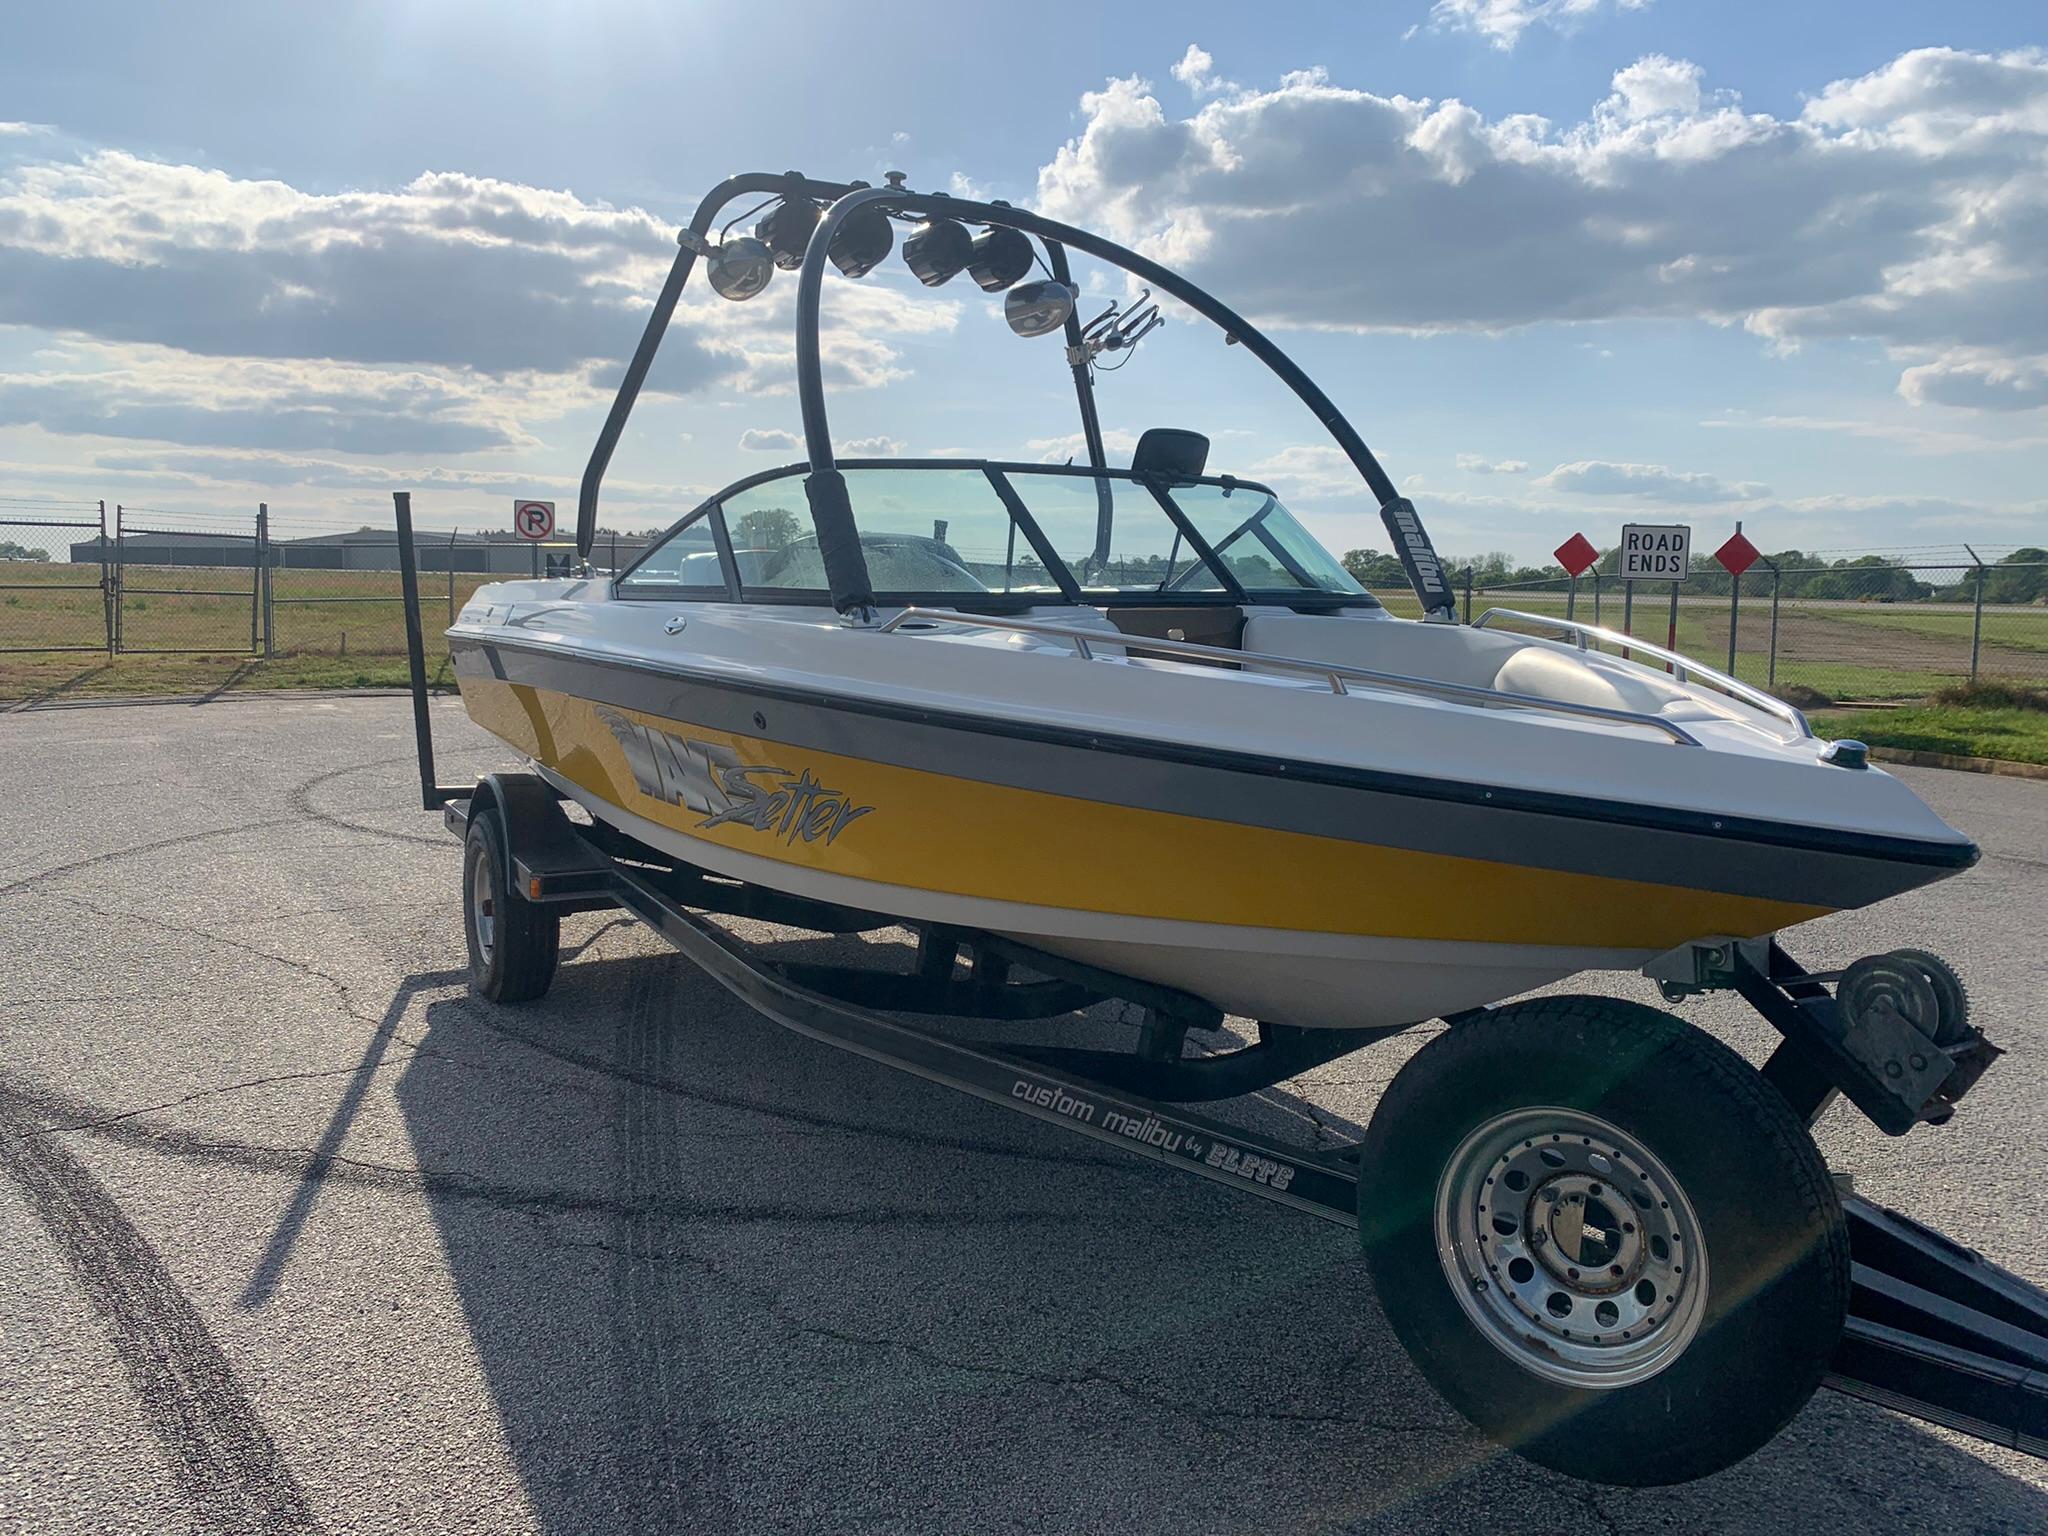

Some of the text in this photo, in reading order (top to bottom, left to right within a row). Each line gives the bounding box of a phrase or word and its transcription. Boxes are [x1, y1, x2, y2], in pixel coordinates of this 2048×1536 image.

[1394, 511, 1444, 593] malibu
[1628, 533, 1683, 551] ROAD
[1628, 554, 1681, 572] ENDS
[694, 768, 876, 846] Setter
[1011, 1080, 1095, 1122] custom
[1102, 1111, 1182, 1152] malibu
[1184, 1135, 1202, 1158] by
